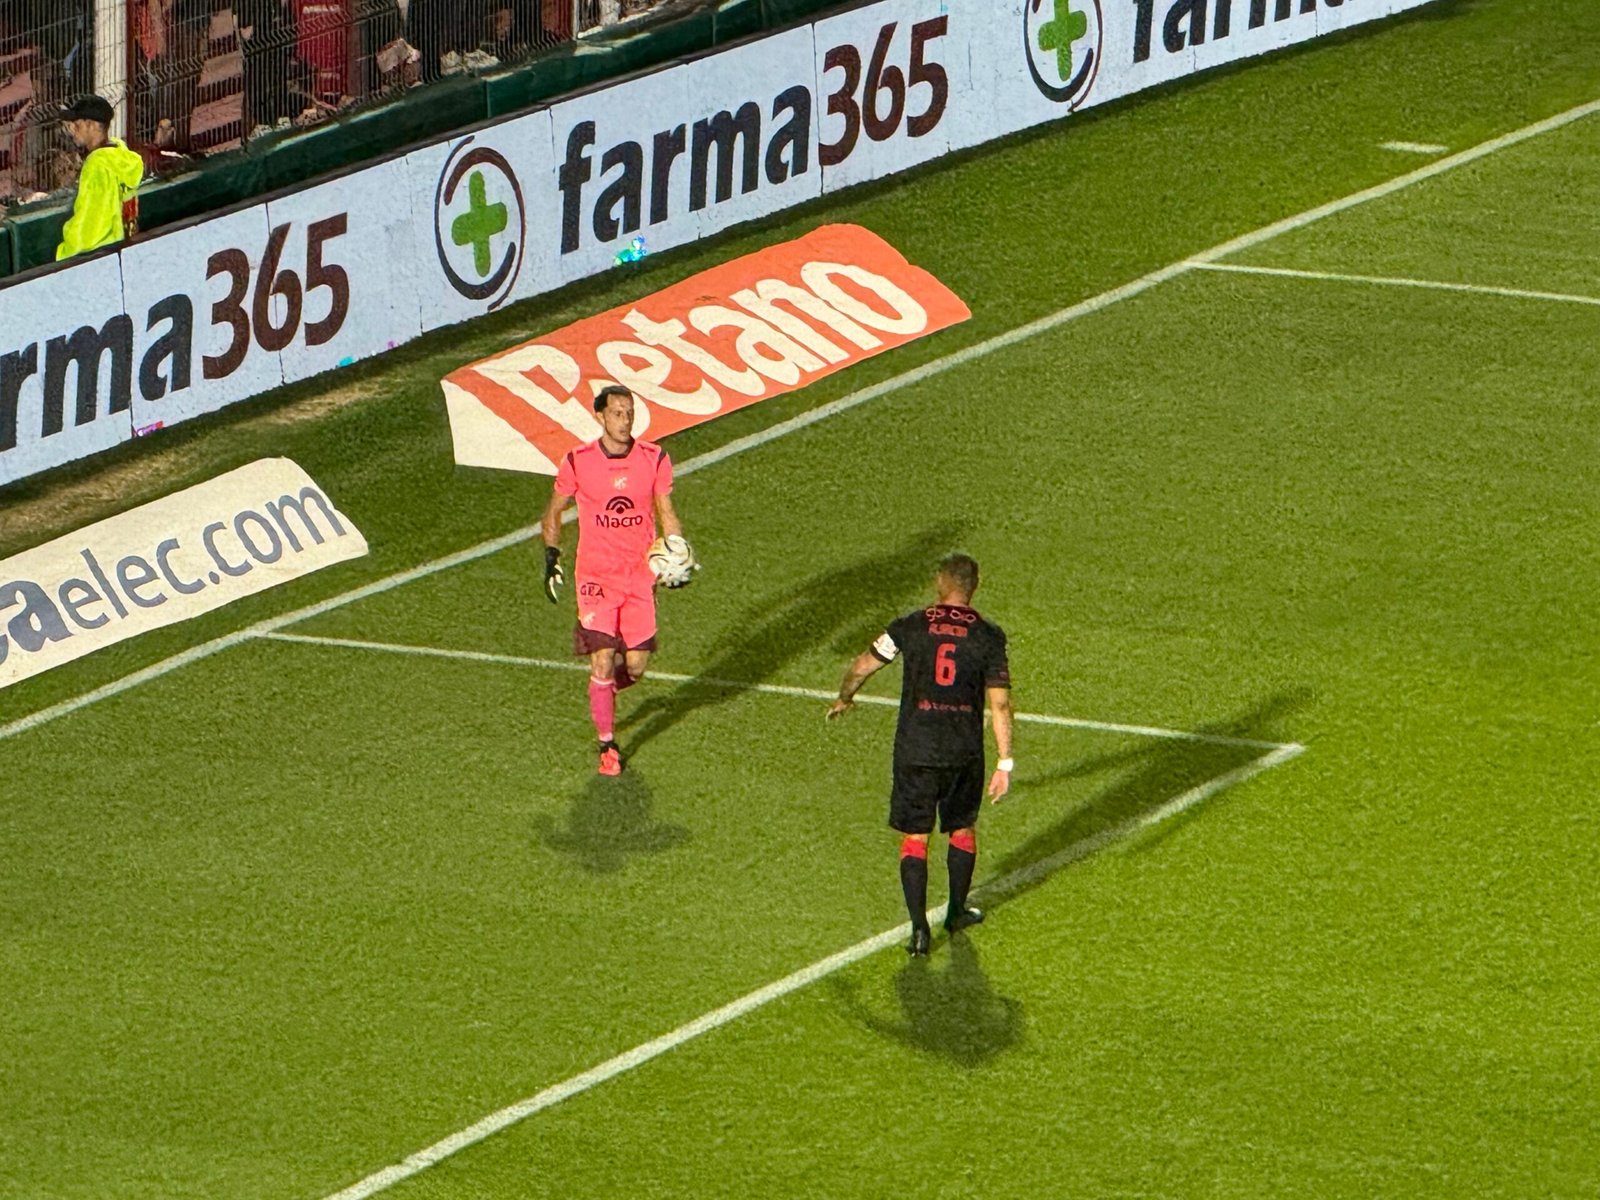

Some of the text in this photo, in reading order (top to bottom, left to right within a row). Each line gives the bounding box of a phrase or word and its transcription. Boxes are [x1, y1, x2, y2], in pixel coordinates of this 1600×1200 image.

[558, 15, 949, 255] farma365
[472, 260, 928, 442] Betano
[0, 486, 348, 666] aelec.com
[595, 513, 644, 529] Macro
[579, 582, 605, 599] GEA
[935, 642, 957, 687] 6
